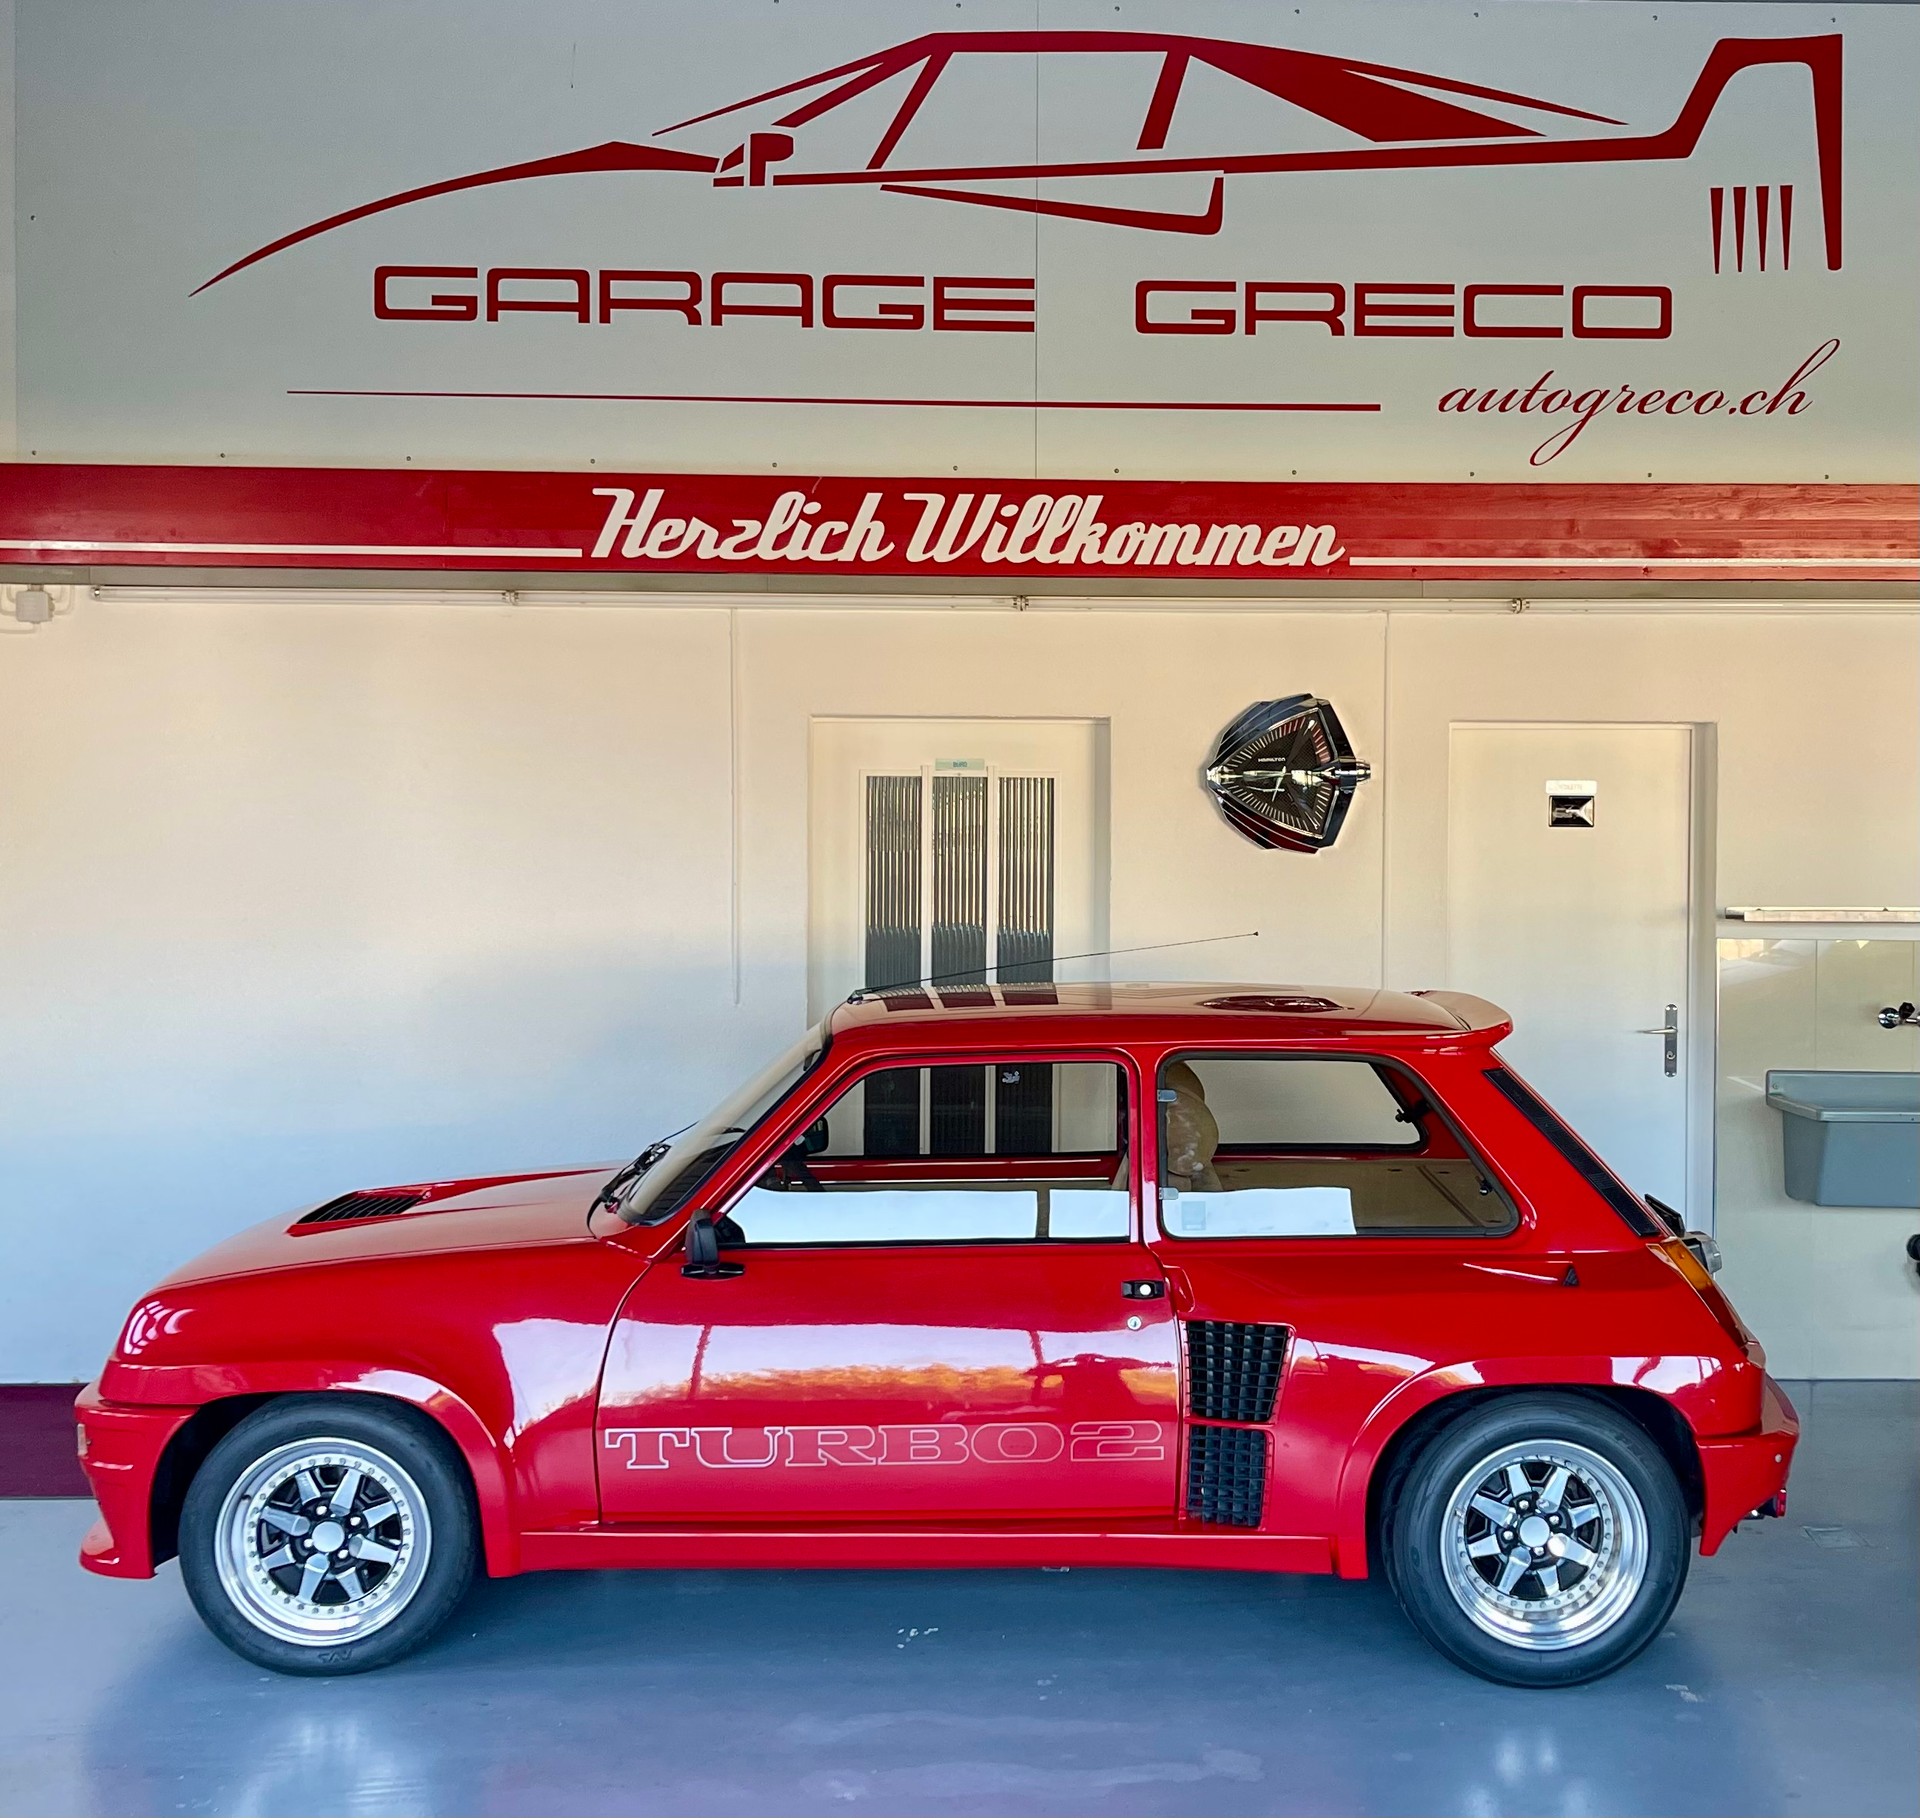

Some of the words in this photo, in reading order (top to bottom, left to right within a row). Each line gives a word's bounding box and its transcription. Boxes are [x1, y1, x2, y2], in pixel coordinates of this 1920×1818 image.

[375, 267, 1035, 331] GARAGE
[1136, 280, 1671, 339] GRECO
[1438, 338, 1840, 467] autogreco.ch
[591, 488, 895, 562] Herzlich
[903, 491, 1346, 566] Willkommen
